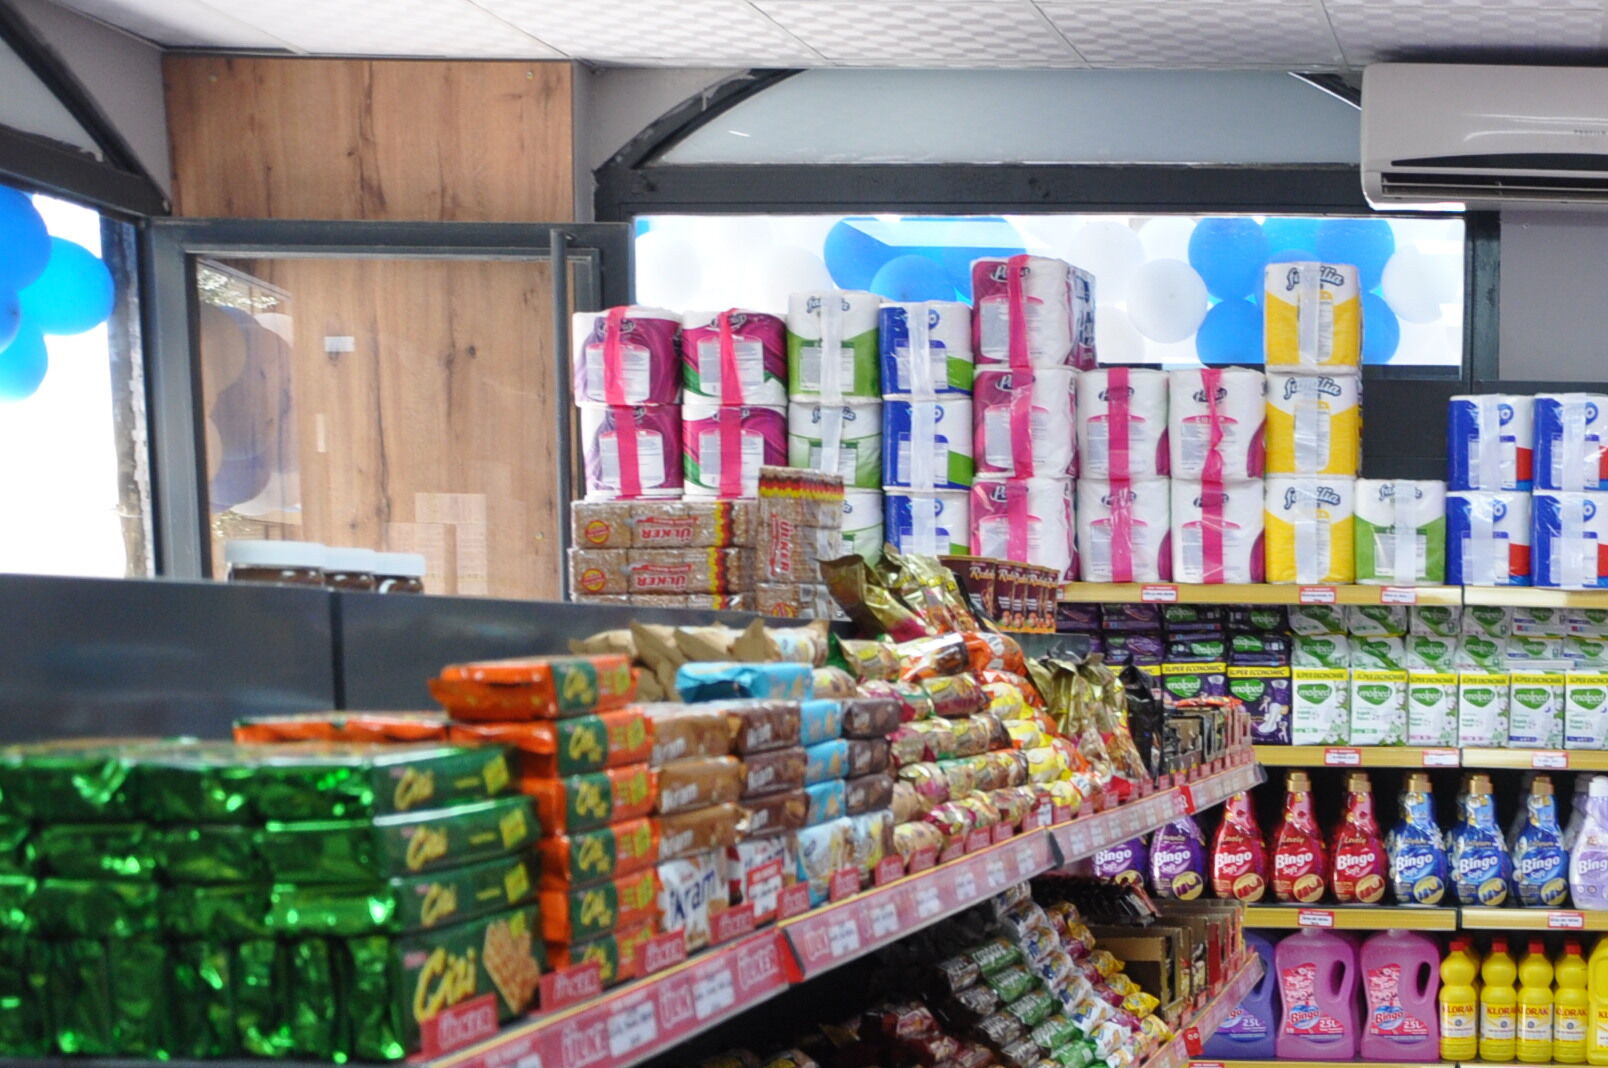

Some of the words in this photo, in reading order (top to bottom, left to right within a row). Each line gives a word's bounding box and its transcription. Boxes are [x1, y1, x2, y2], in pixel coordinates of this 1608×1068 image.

[1166, 679, 1200, 692] molped
[1231, 682, 1264, 695] molped
[1297, 686, 1330, 700] molped
[1358, 687, 1392, 701] molped
[1096, 849, 1132, 868] Bingo
[1154, 849, 1190, 868] Bingo
[1215, 851, 1252, 870] Bingo
[1275, 852, 1312, 870] Bingo
[1336, 852, 1375, 871] Bingo
[1396, 853, 1433, 872] Bingo
[1460, 855, 1498, 874] Bingo
[1522, 855, 1561, 874] Bingo
